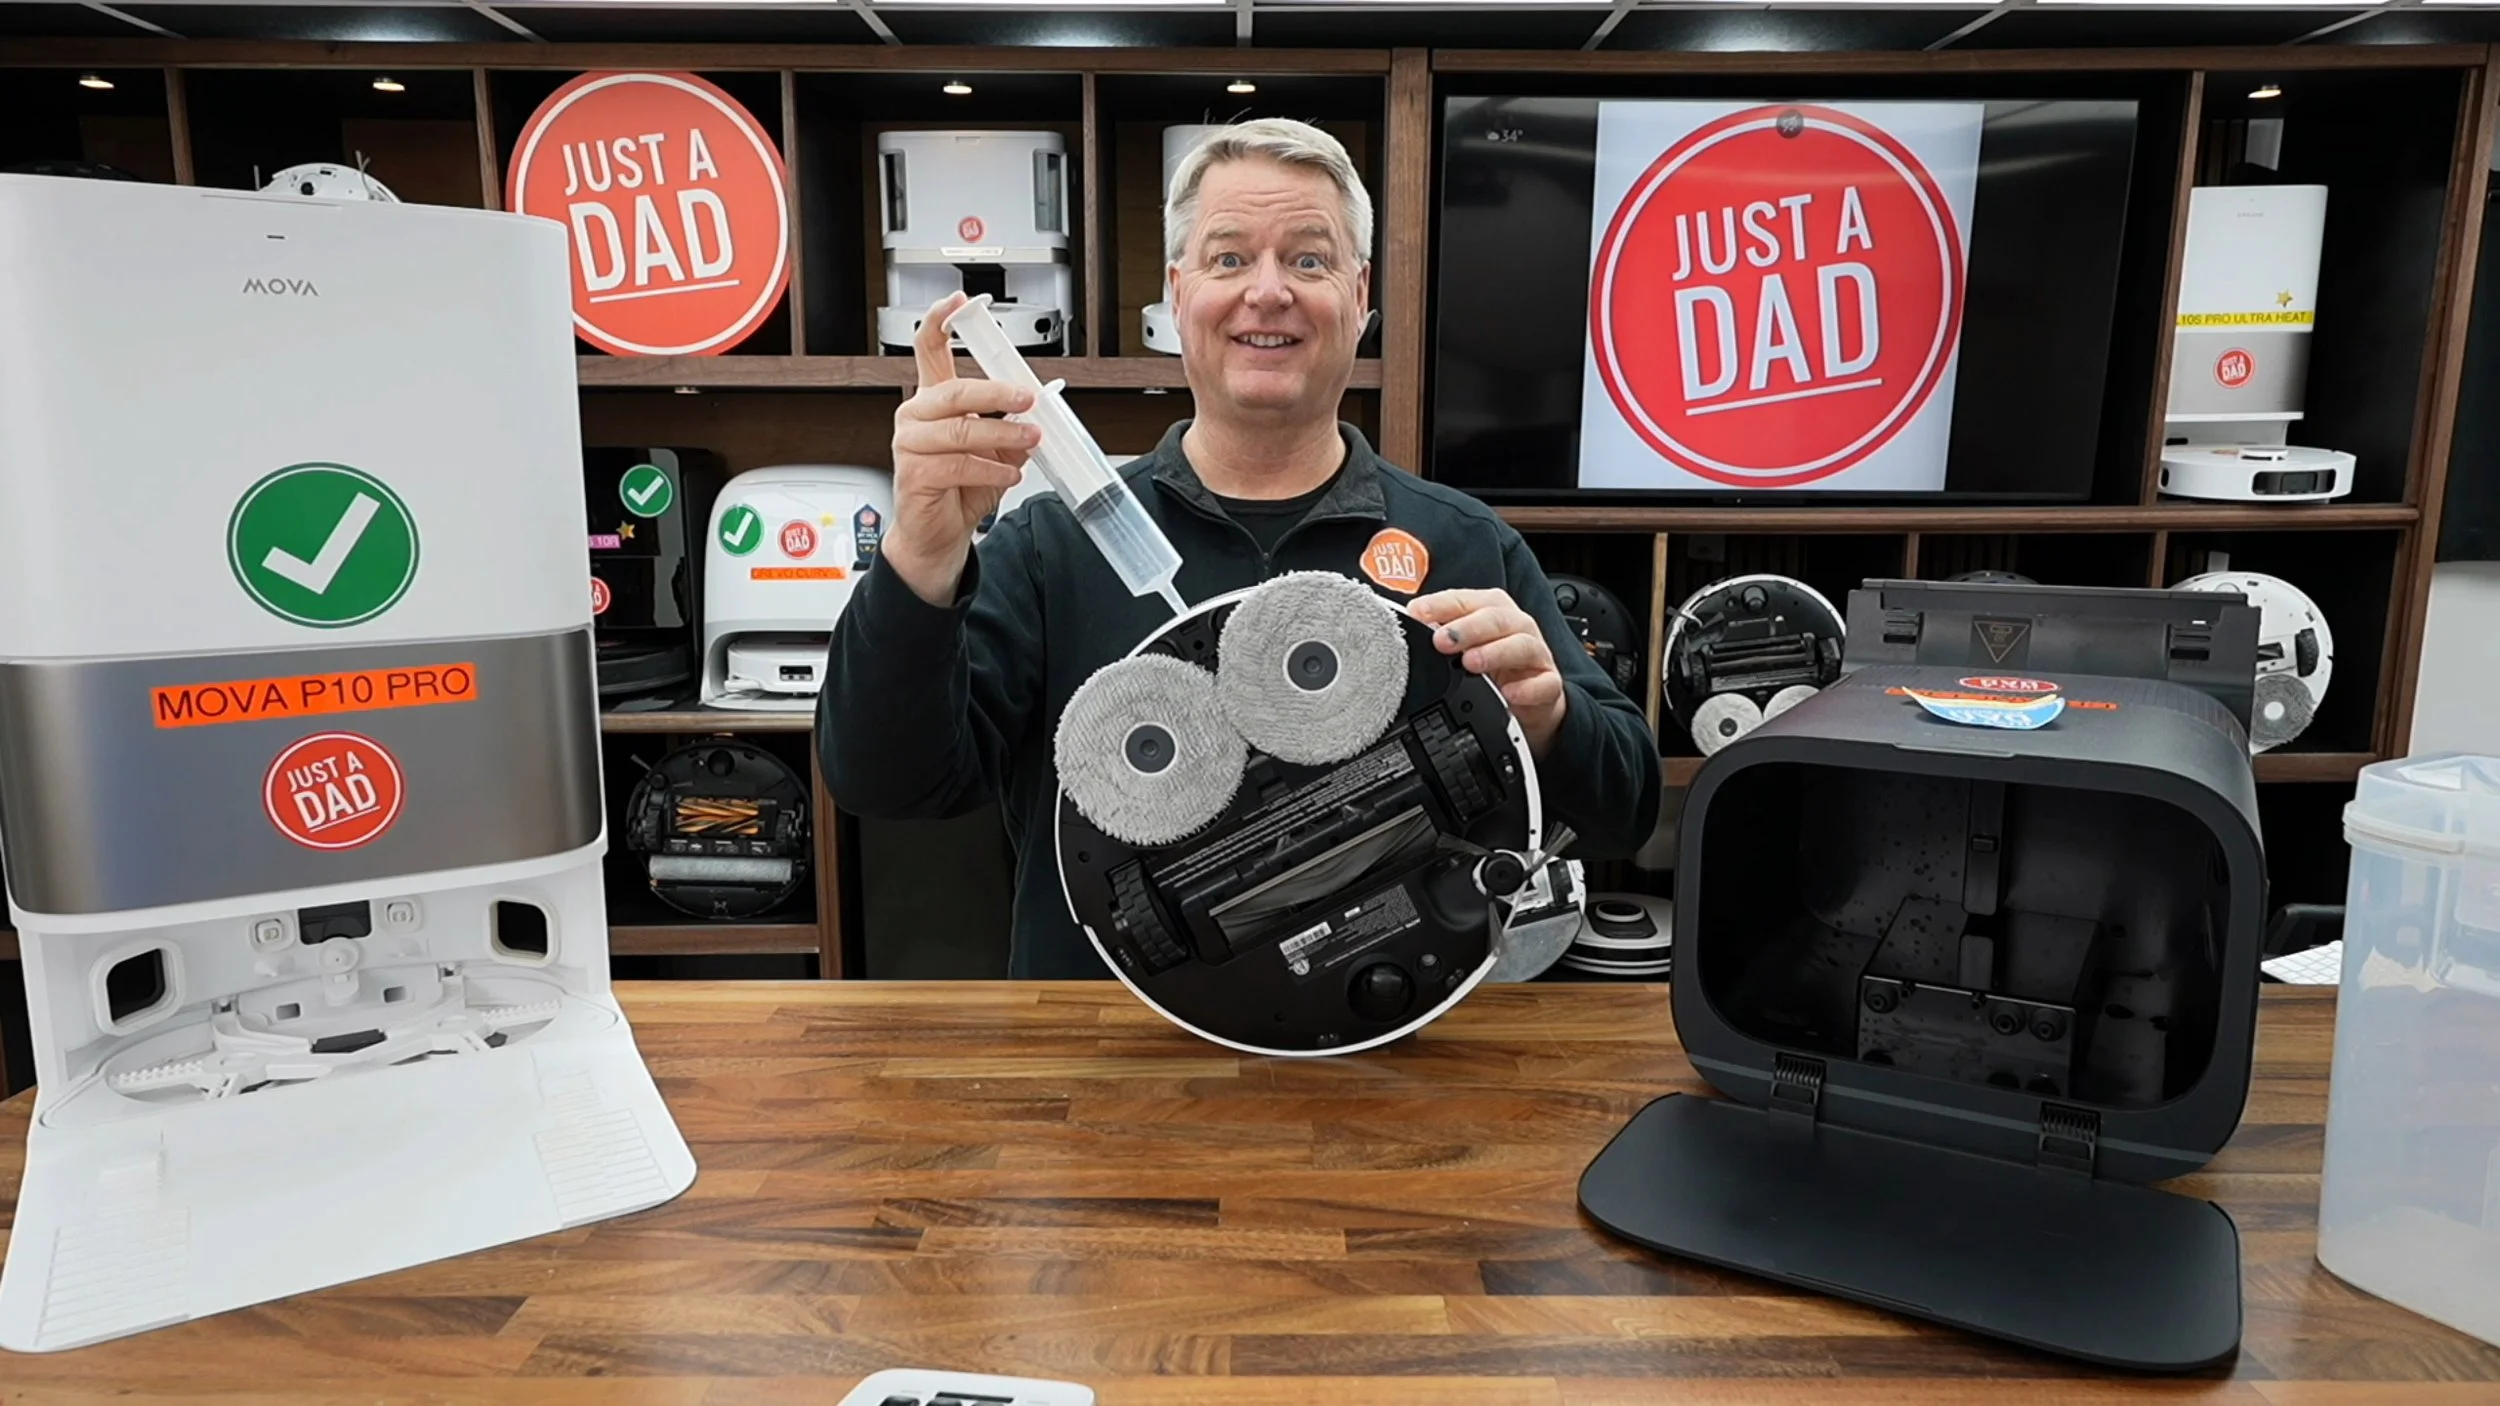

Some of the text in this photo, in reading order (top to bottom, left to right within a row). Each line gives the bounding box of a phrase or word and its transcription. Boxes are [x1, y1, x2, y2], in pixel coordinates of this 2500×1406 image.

[563, 128, 719, 196] JUST A
[568, 188, 733, 292] DAD
[1672, 186, 1873, 281] JUST A
[243, 278, 319, 297] MOVA
[1674, 261, 1880, 401] DAD
[2204, 313, 2231, 325] PRO
[2234, 312, 2274, 324] ULTRA
[2275, 311, 2306, 323] HEAT
[2222, 363, 2246, 381] DAD
[786, 534, 810, 552] DAD
[1373, 542, 1415, 557] JUST A
[1375, 554, 1417, 577] DAD
[158, 667, 470, 721] MOVA P10 PRO
[287, 751, 364, 793] JUST A
[293, 773, 379, 830] DAD
